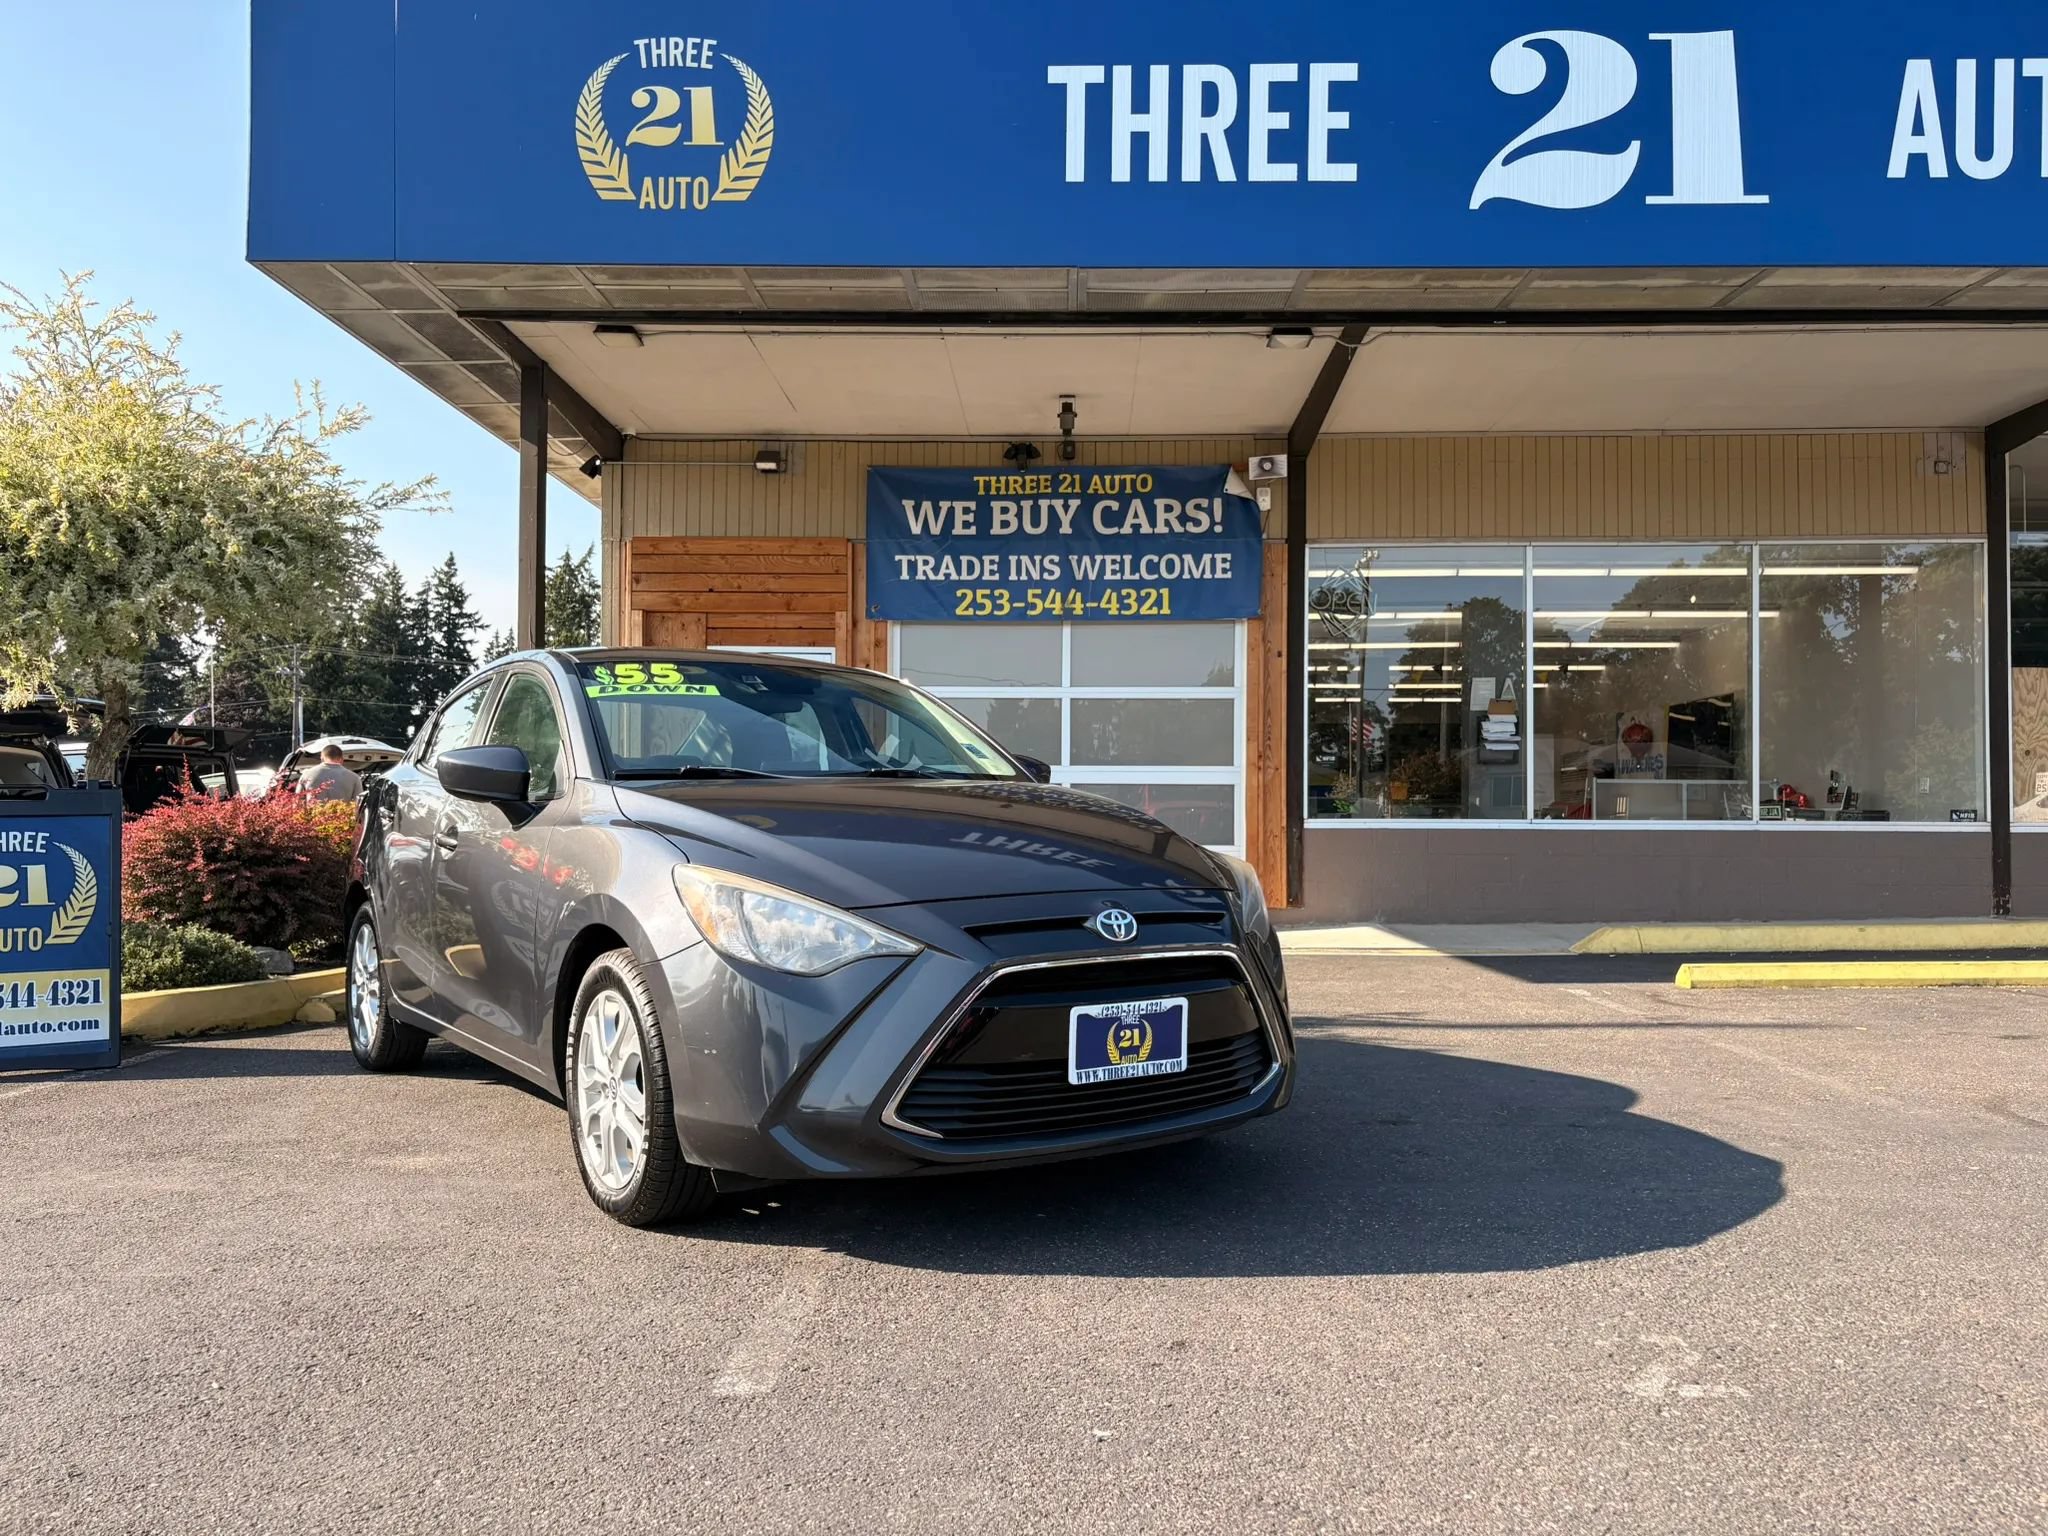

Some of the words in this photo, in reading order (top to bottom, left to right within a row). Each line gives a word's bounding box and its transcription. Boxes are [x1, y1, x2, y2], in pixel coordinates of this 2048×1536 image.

[633, 36, 718, 70] THREE
[625, 85, 725, 147] 21
[1047, 62, 1359, 184] THREE
[1468, 29, 1770, 211] 21
[638, 175, 710, 211] AUTO
[973, 475, 1052, 496] THREE
[1059, 473, 1082, 494] 21
[1087, 473, 1153, 495] AUTO
[901, 499, 977, 536] WE
[989, 498, 1082, 536] BUY
[1092, 497, 1224, 535] CARS!
[894, 554, 1000, 582] TRADE
[1008, 554, 1061, 581] INS
[1068, 552, 1233, 581] WELCOME
[954, 587, 1172, 617] 253-544-4321
[1310, 586, 1378, 617] OPEN
[594, 663, 685, 685] $55
[598, 685, 708, 694] DOWN
[0, 1019, 99, 1036] auto.com
[1121, 1014, 1140, 1025] THREE
[1118, 1028, 1141, 1048] 21
[1076, 1060, 1183, 1084] WWW.THREE21AUTO.COM
[1121, 1054, 1138, 1065] AUTO
